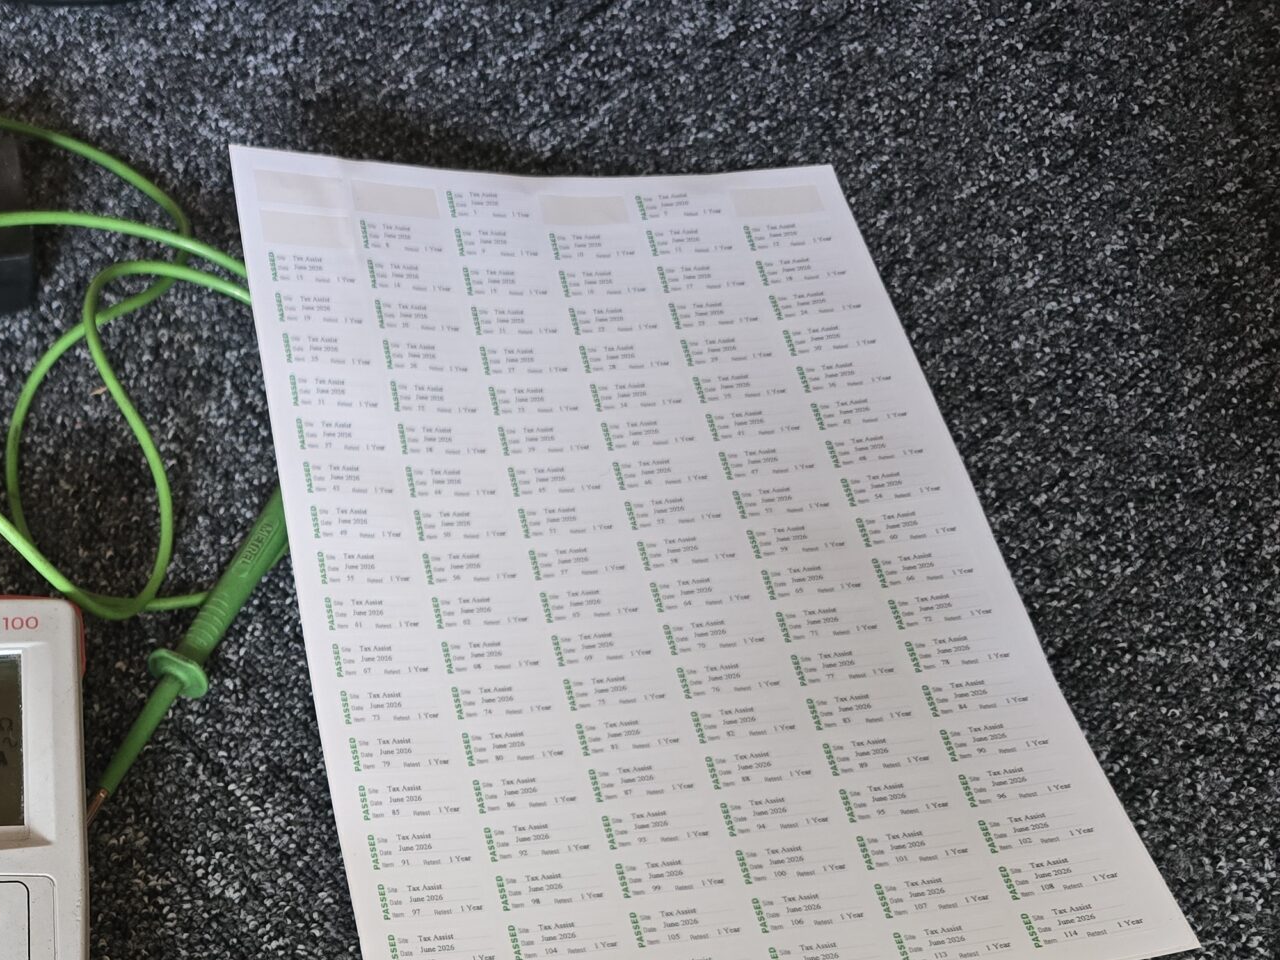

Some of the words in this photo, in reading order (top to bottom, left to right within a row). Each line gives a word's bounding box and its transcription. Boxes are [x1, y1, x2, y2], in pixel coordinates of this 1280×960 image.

[2, 616, 39, 631] 100
[332, 643, 344, 678] PASSED
[1051, 908, 1067, 916] Tax
[1069, 903, 1092, 912] Assist
[1057, 918, 1075, 926] June
[1077, 914, 1096, 923] 2026
[923, 928, 939, 936] Tax
[940, 925, 963, 934] Assist
[1021, 913, 1043, 949] PASSED
[1063, 930, 1078, 938] 114
[1124, 918, 1144, 927] Year
[433, 933, 454, 941] Assist
[928, 938, 946, 947] June
[946, 935, 966, 944] 2026
[437, 944, 455, 952] 2026
[934, 952, 948, 960] 113
[992, 941, 1011, 950] Year
